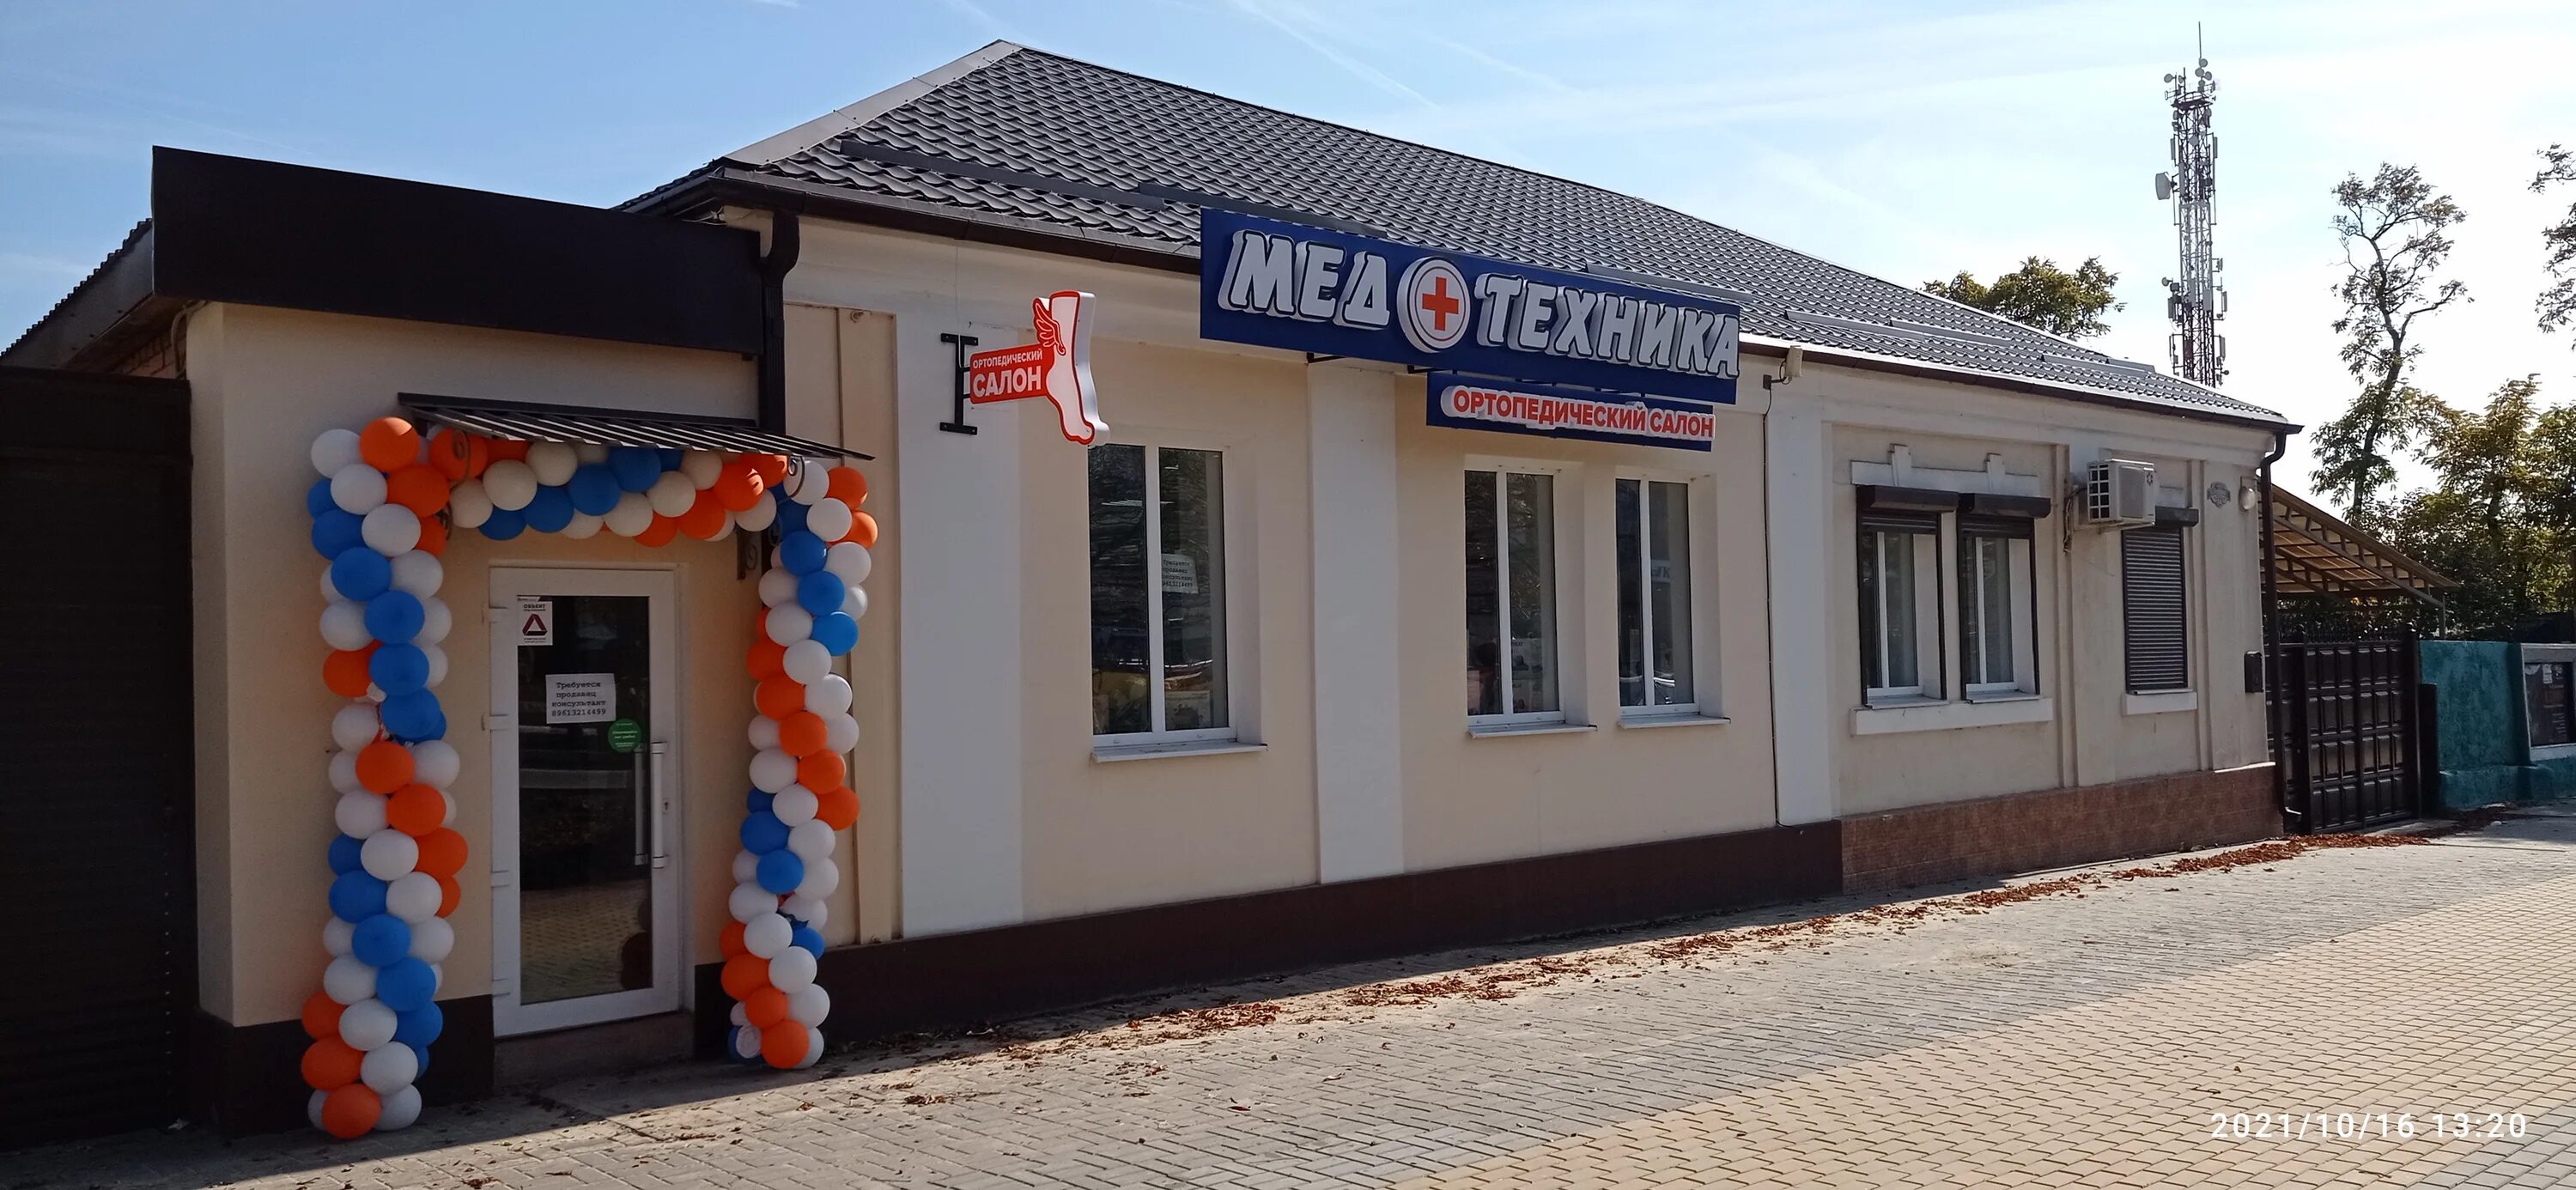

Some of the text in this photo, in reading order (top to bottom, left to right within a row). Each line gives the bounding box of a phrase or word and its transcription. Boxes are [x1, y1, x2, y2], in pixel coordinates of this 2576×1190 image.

[1218, 229, 1740, 378] МЕД ТЕХНИКА
[972, 348, 1043, 369] ОРТОПЕДИЧЕСКИЙ
[973, 365, 1042, 398] САЛОН
[1453, 388, 1714, 439] ОРТОПЕДИЧЕСКИЙ САЛОН
[556, 681, 601, 690] Требуется
[556, 691, 598, 700] продавец
